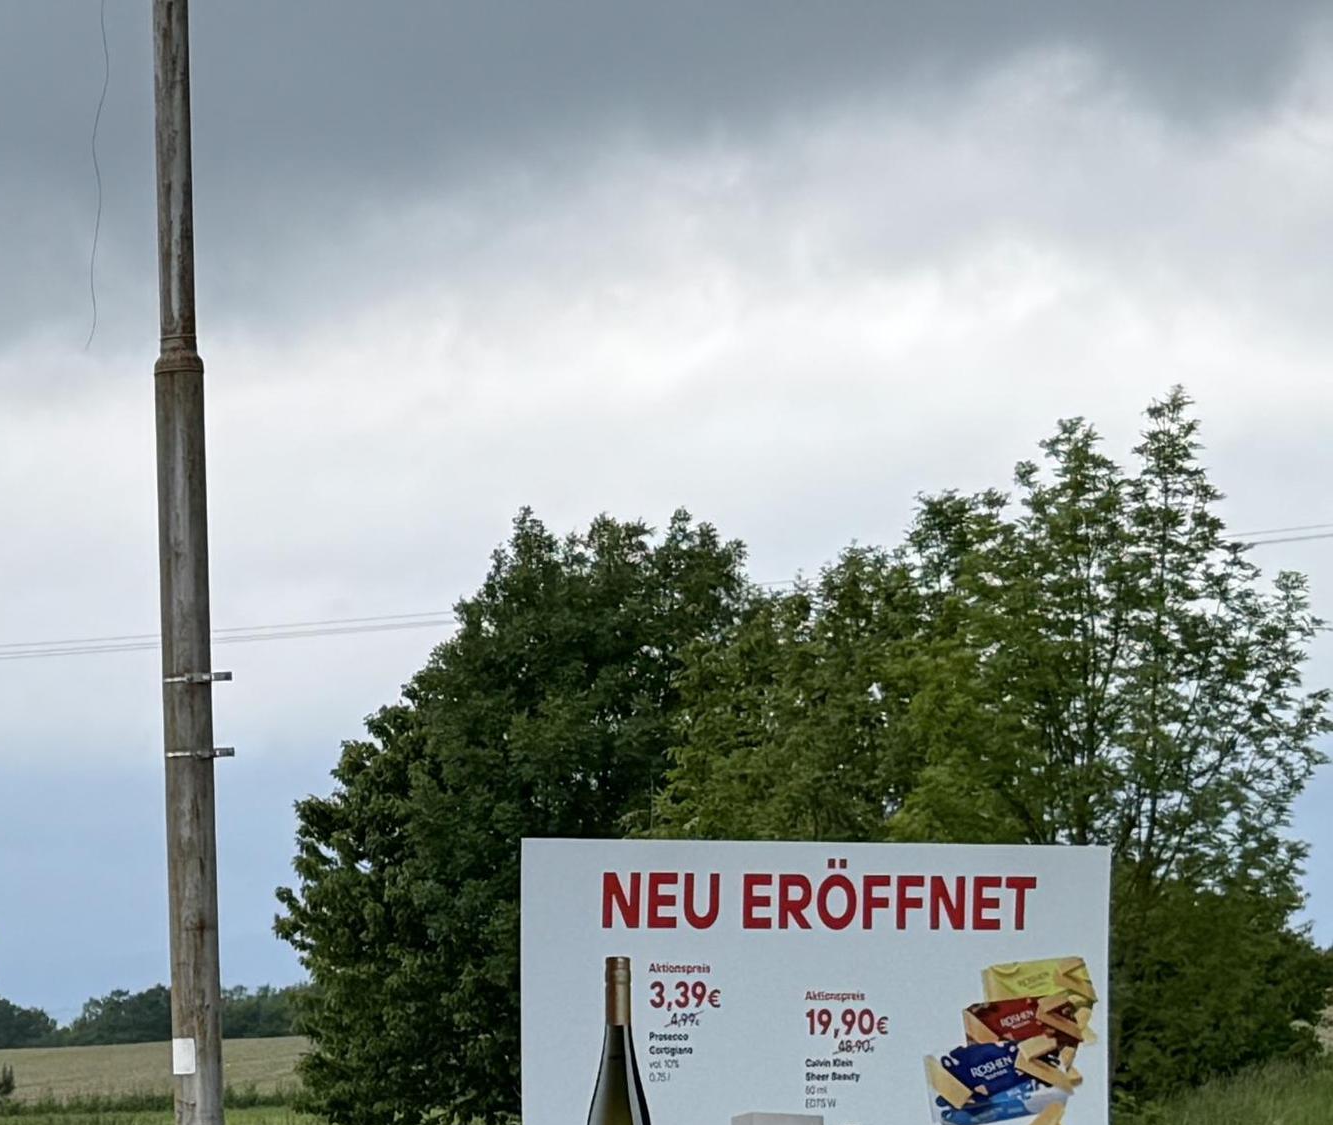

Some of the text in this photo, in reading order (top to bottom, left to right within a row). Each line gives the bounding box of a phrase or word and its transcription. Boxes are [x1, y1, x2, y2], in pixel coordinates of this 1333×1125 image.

[602, 858, 1037, 931] NEU ERÖFFNET
[649, 963, 711, 975] Aktionspreis
[650, 981, 721, 1012] 3,39€
[805, 991, 865, 1003] Aktionspreis
[806, 1008, 889, 1039] 19,90€
[1000, 1009, 1035, 1028] ROSHEN
[649, 1031, 689, 1041] Prosecco
[805, 1058, 853, 1068] Calvin Klein
[970, 1055, 1013, 1078] ROSHEN
